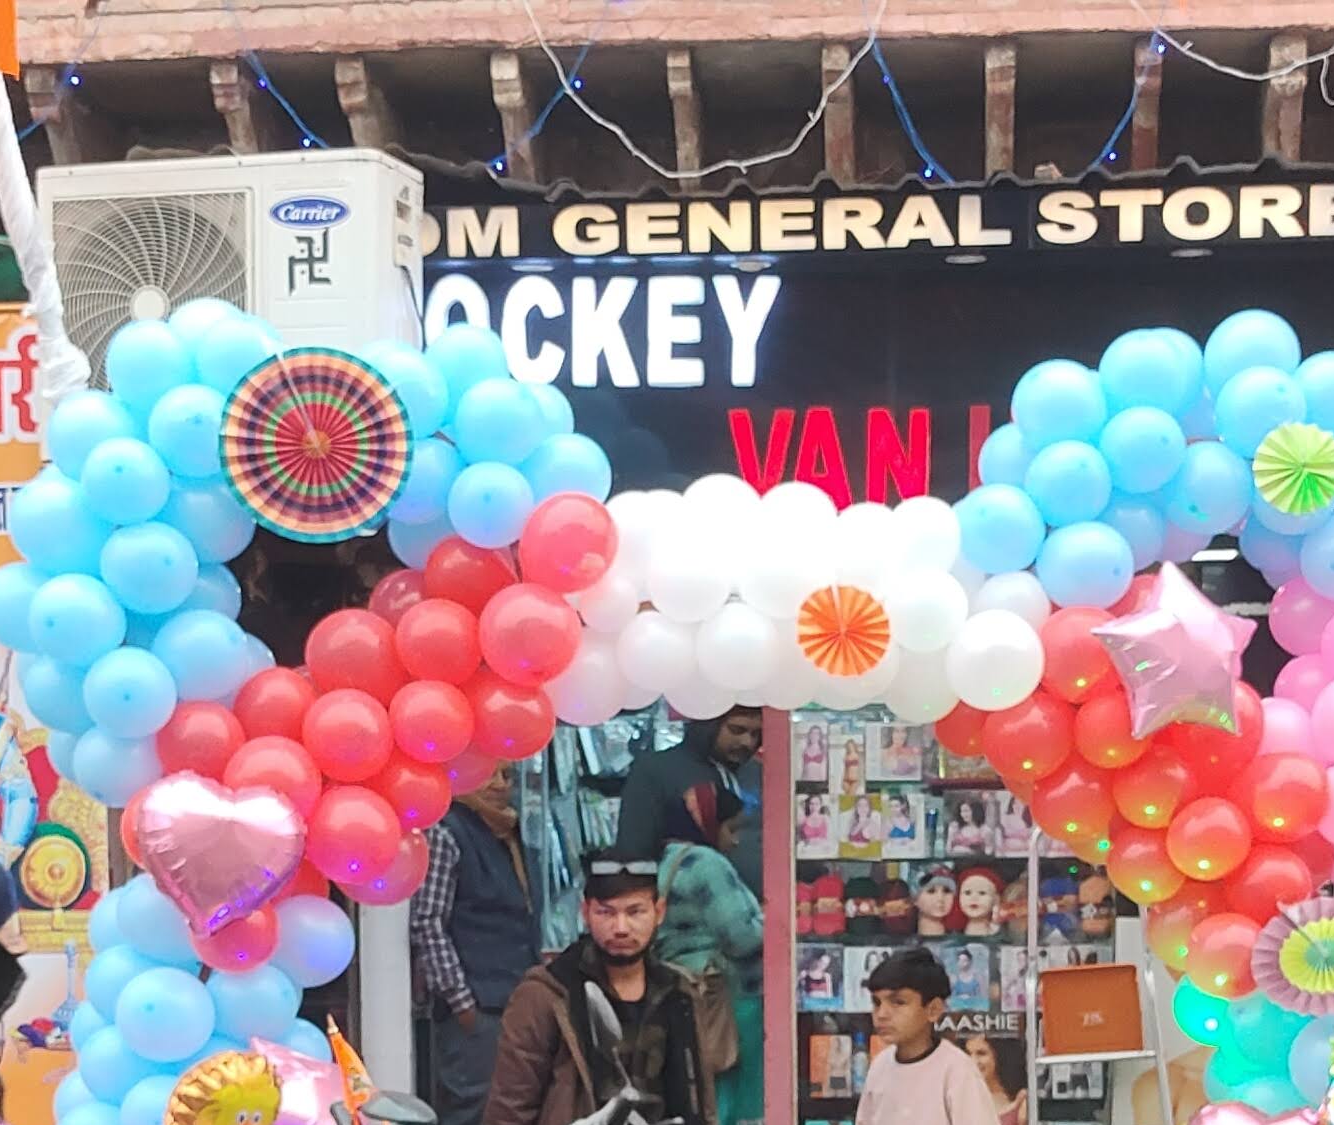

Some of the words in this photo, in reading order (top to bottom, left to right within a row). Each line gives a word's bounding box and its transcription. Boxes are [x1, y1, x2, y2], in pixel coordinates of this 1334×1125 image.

[278, 204, 341, 221] Carrier
[422, 205, 521, 257] M
[552, 190, 1013, 255] GENERAL
[727, 405, 931, 516] VAN
[934, 1013, 1019, 1032] AASHIE
